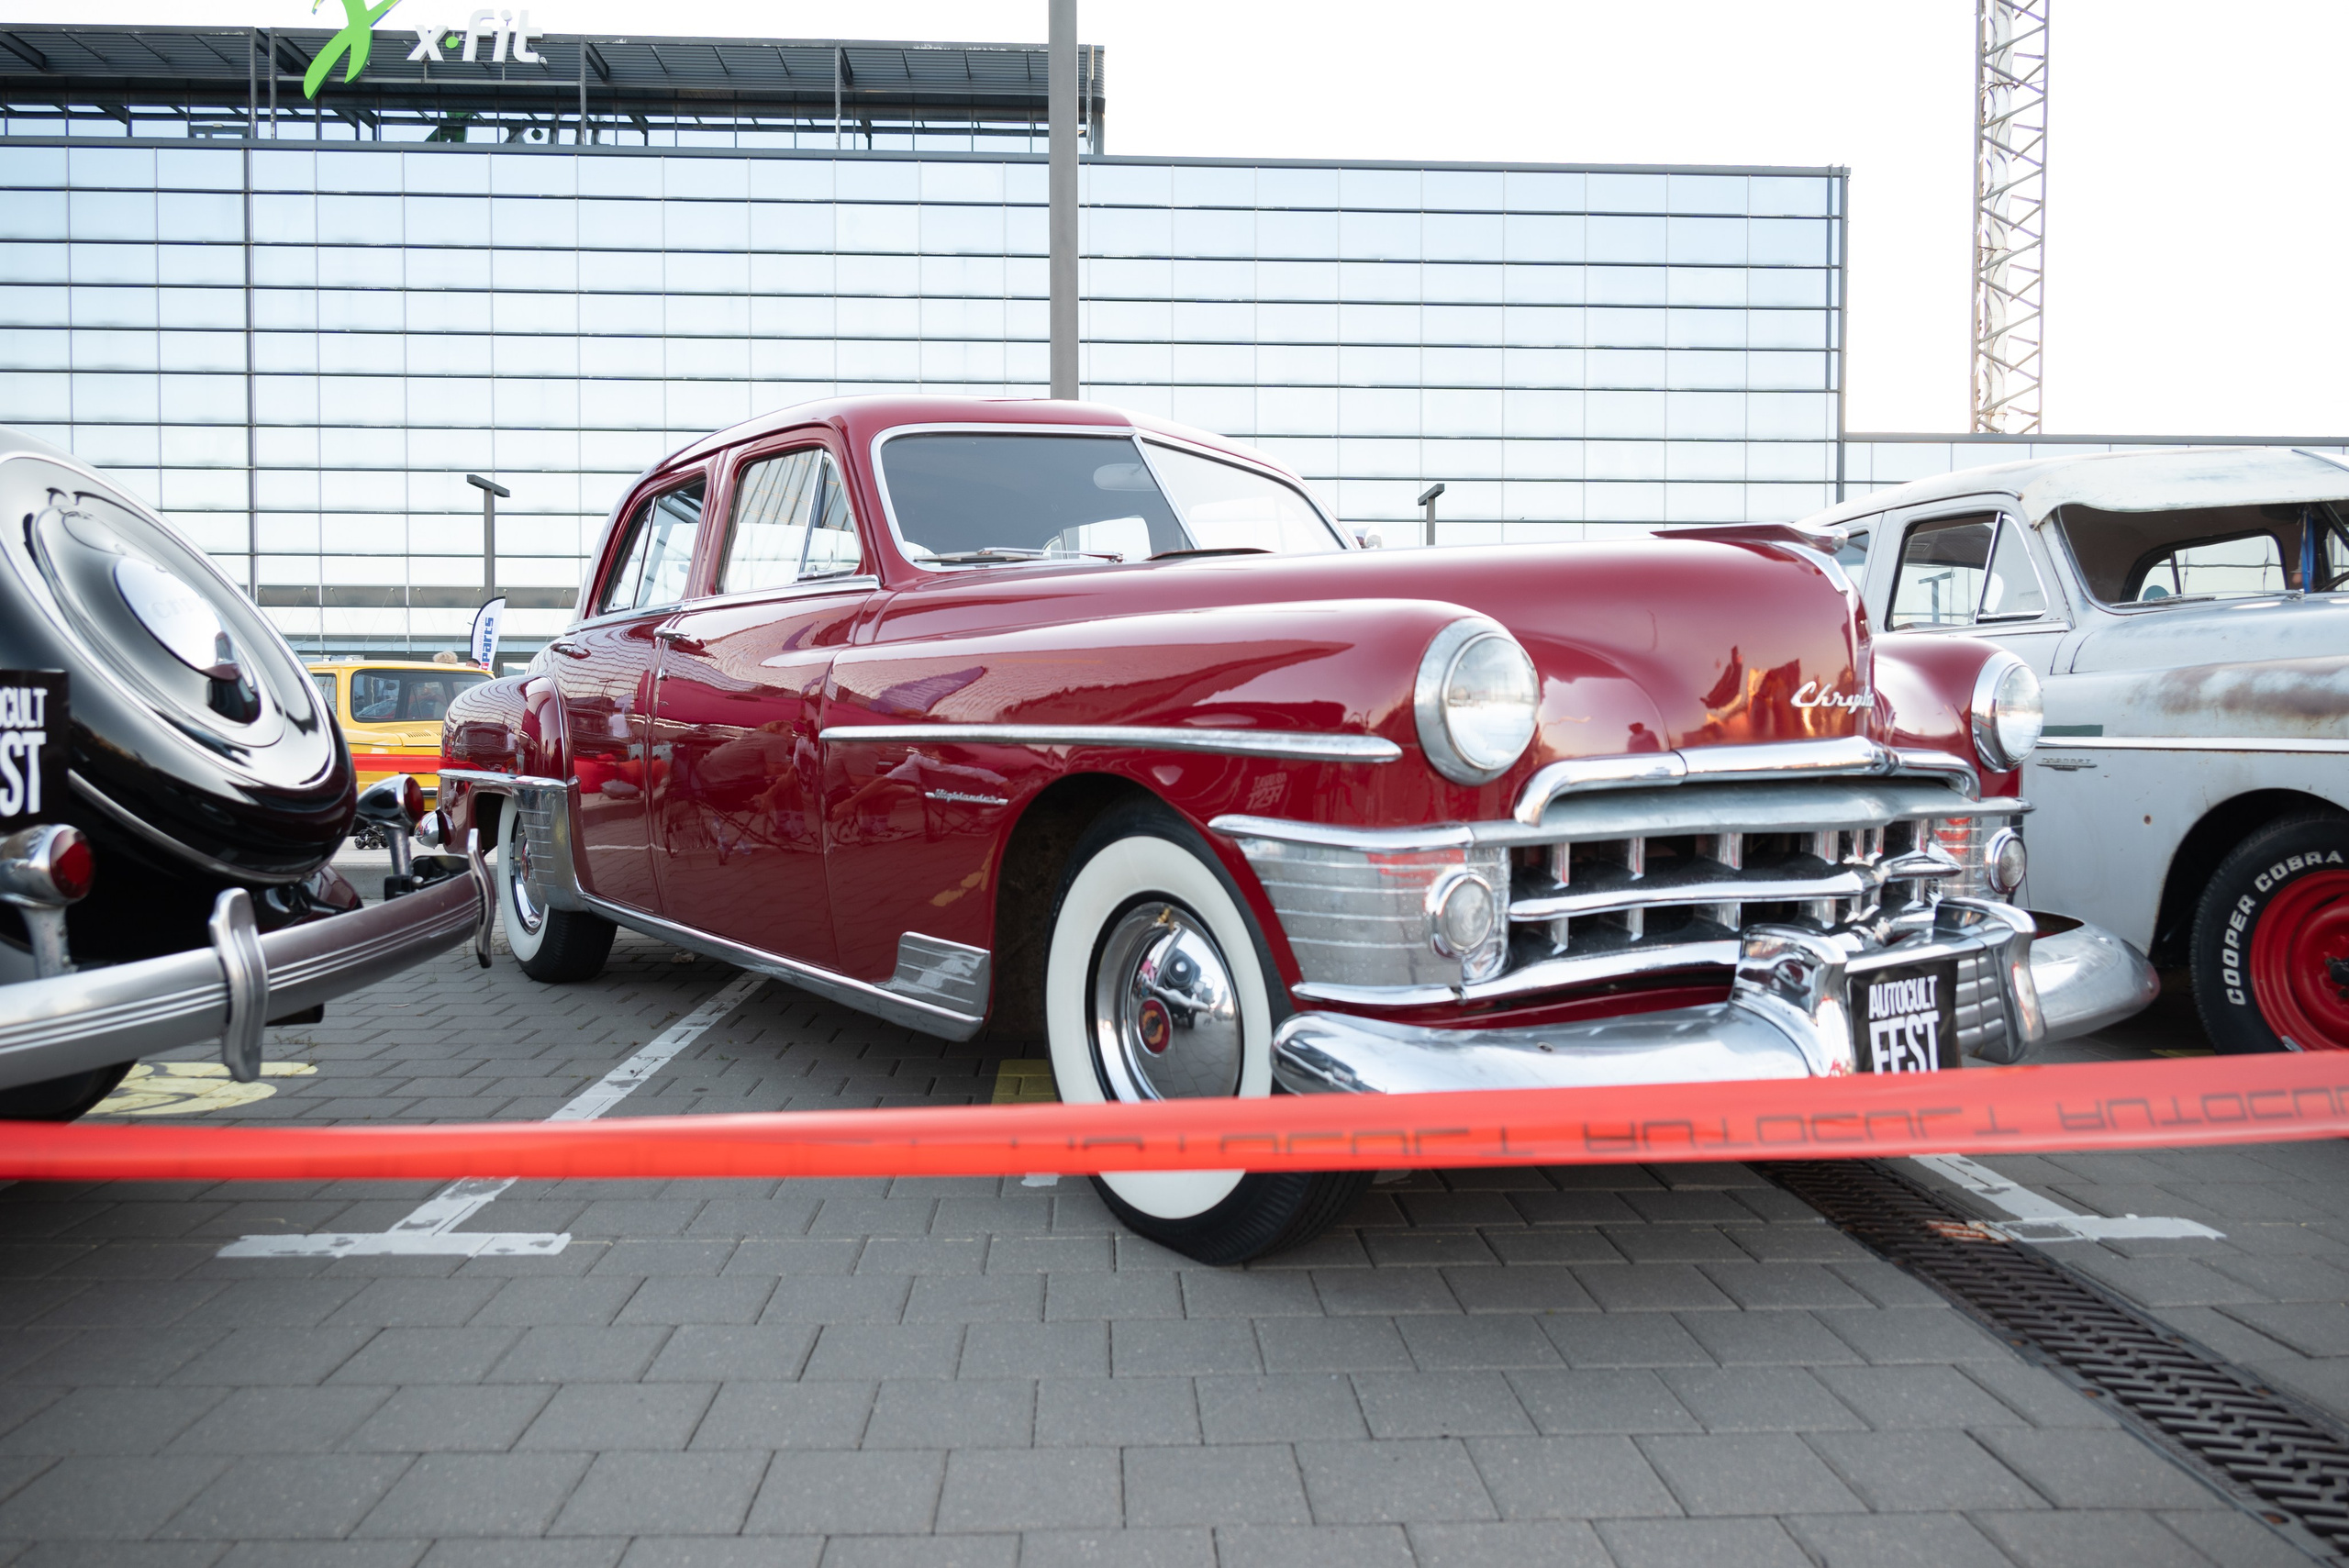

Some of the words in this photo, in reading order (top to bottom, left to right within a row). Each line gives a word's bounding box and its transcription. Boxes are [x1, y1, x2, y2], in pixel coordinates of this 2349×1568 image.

[2222, 894, 2256, 1006] COOPER
[2254, 851, 2343, 893] COBRA
[1868, 974, 1938, 1019] AUTOCULT
[1868, 1010, 1940, 1075] FEST
